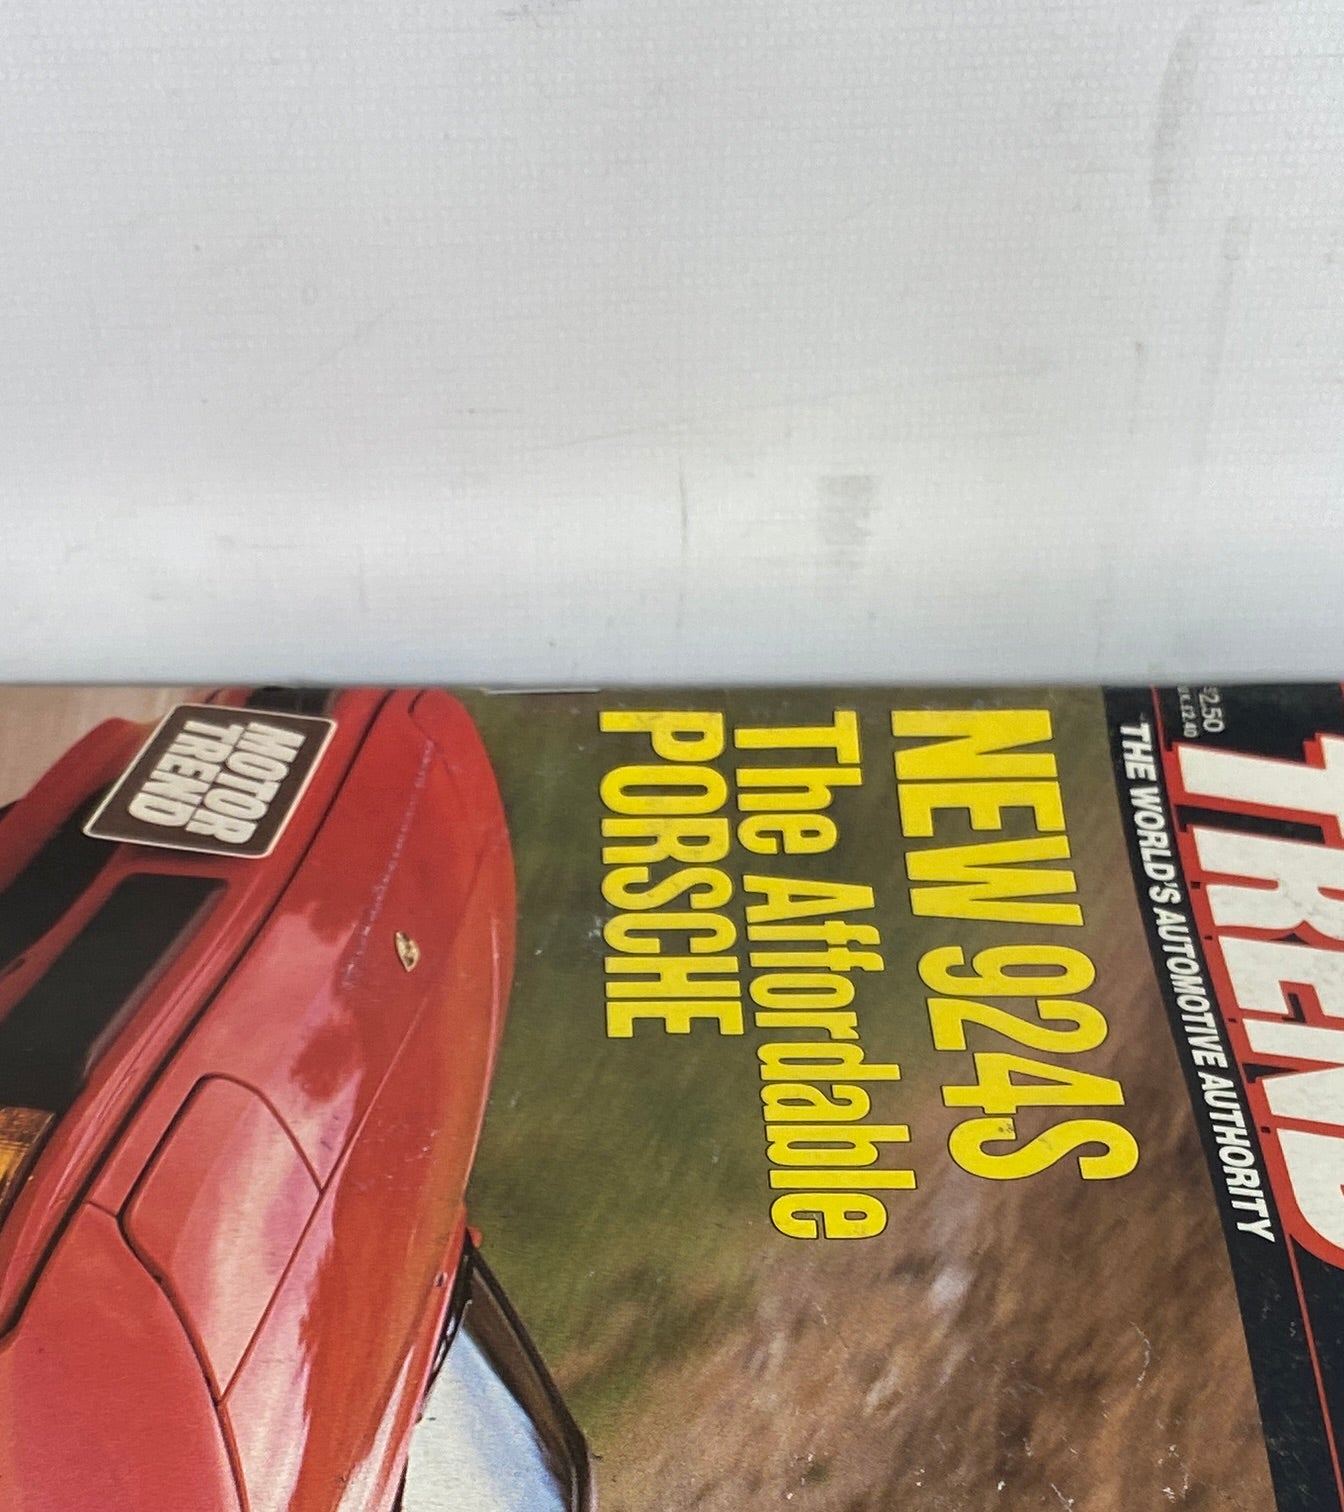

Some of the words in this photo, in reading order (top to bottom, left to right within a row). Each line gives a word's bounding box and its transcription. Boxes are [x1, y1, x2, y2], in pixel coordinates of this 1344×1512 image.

[128, 719, 245, 827] TREND
[186, 721, 306, 844] MOTOR
[734, 709, 862, 854] The
[891, 709, 1084, 926] NEW
[1120, 722, 1154, 780] THE
[599, 710, 744, 1038] PORSCHE
[1132, 785, 1182, 904] WORLD'S
[743, 873, 917, 1239] Affordable
[918, 944, 1140, 1180] 924S
[1152, 910, 1227, 1066] AUTOMOTIVE
[1195, 1072, 1275, 1242] AUTHORITY
